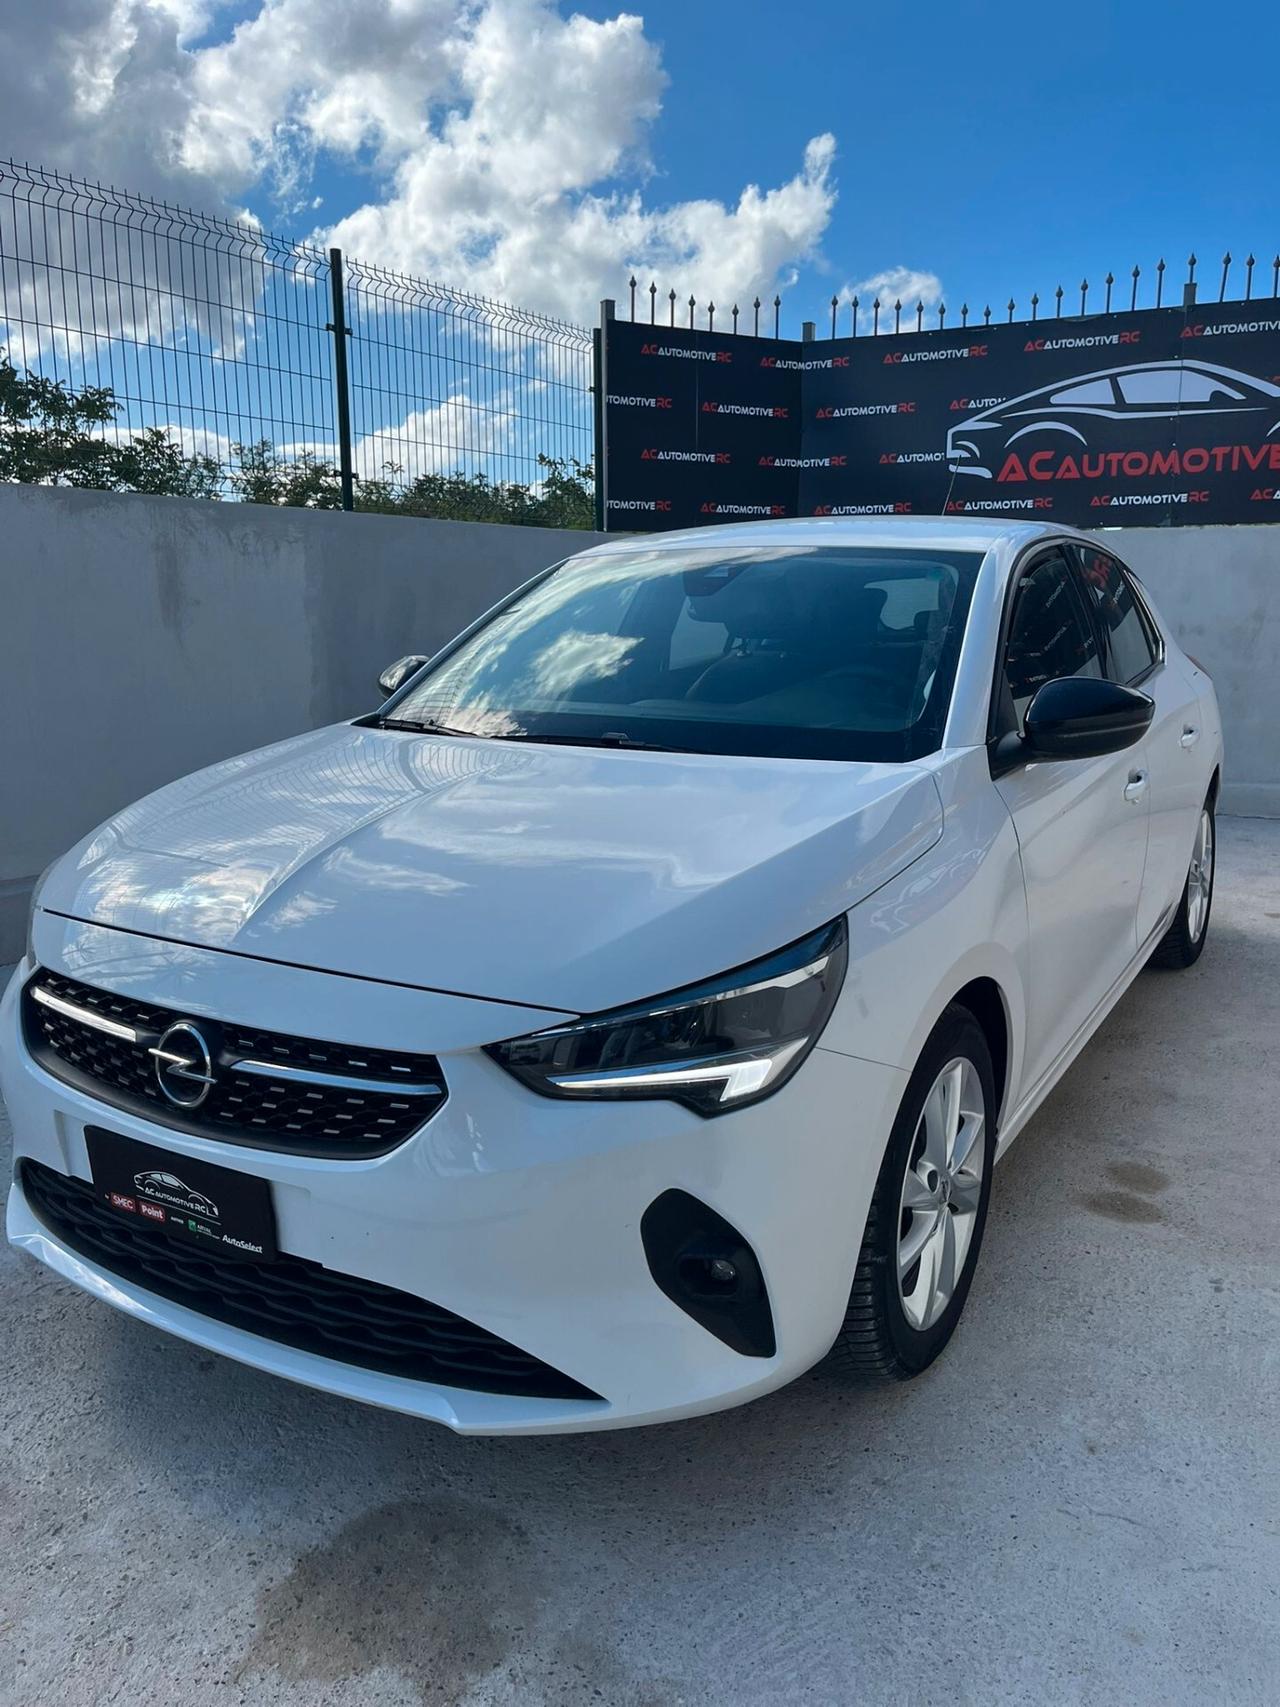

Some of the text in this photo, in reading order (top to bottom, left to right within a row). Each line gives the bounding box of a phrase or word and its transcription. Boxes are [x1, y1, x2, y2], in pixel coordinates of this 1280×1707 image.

[1180, 320, 1280, 338] ACAUTOMOTIV
[1024, 331, 1141, 352] ACAUTOMOTIVERC
[641, 344, 732, 363] ACAUTOMOTIVERC
[883, 345, 988, 364] ACAUTOMOTIVERC
[760, 356, 849, 371] ACAUTOMOTIVERC
[702, 402, 788, 418] ACAUTOMOTIVERC
[816, 402, 916, 419] ACAUTOMOTIVERC
[641, 449, 731, 464] ACAUTOMOTIVERC
[759, 456, 848, 468] ACAUTOMOTIVERC
[946, 497, 1053, 511] ACAUTOMOTIVERC
[1090, 491, 1209, 507] ACAUTOMOTIVERC
[701, 502, 786, 515] ACAUTOMOTIVERC
[814, 502, 912, 516] ACAUTOMOTIVERC
[141, 1204, 164, 1220] Point
